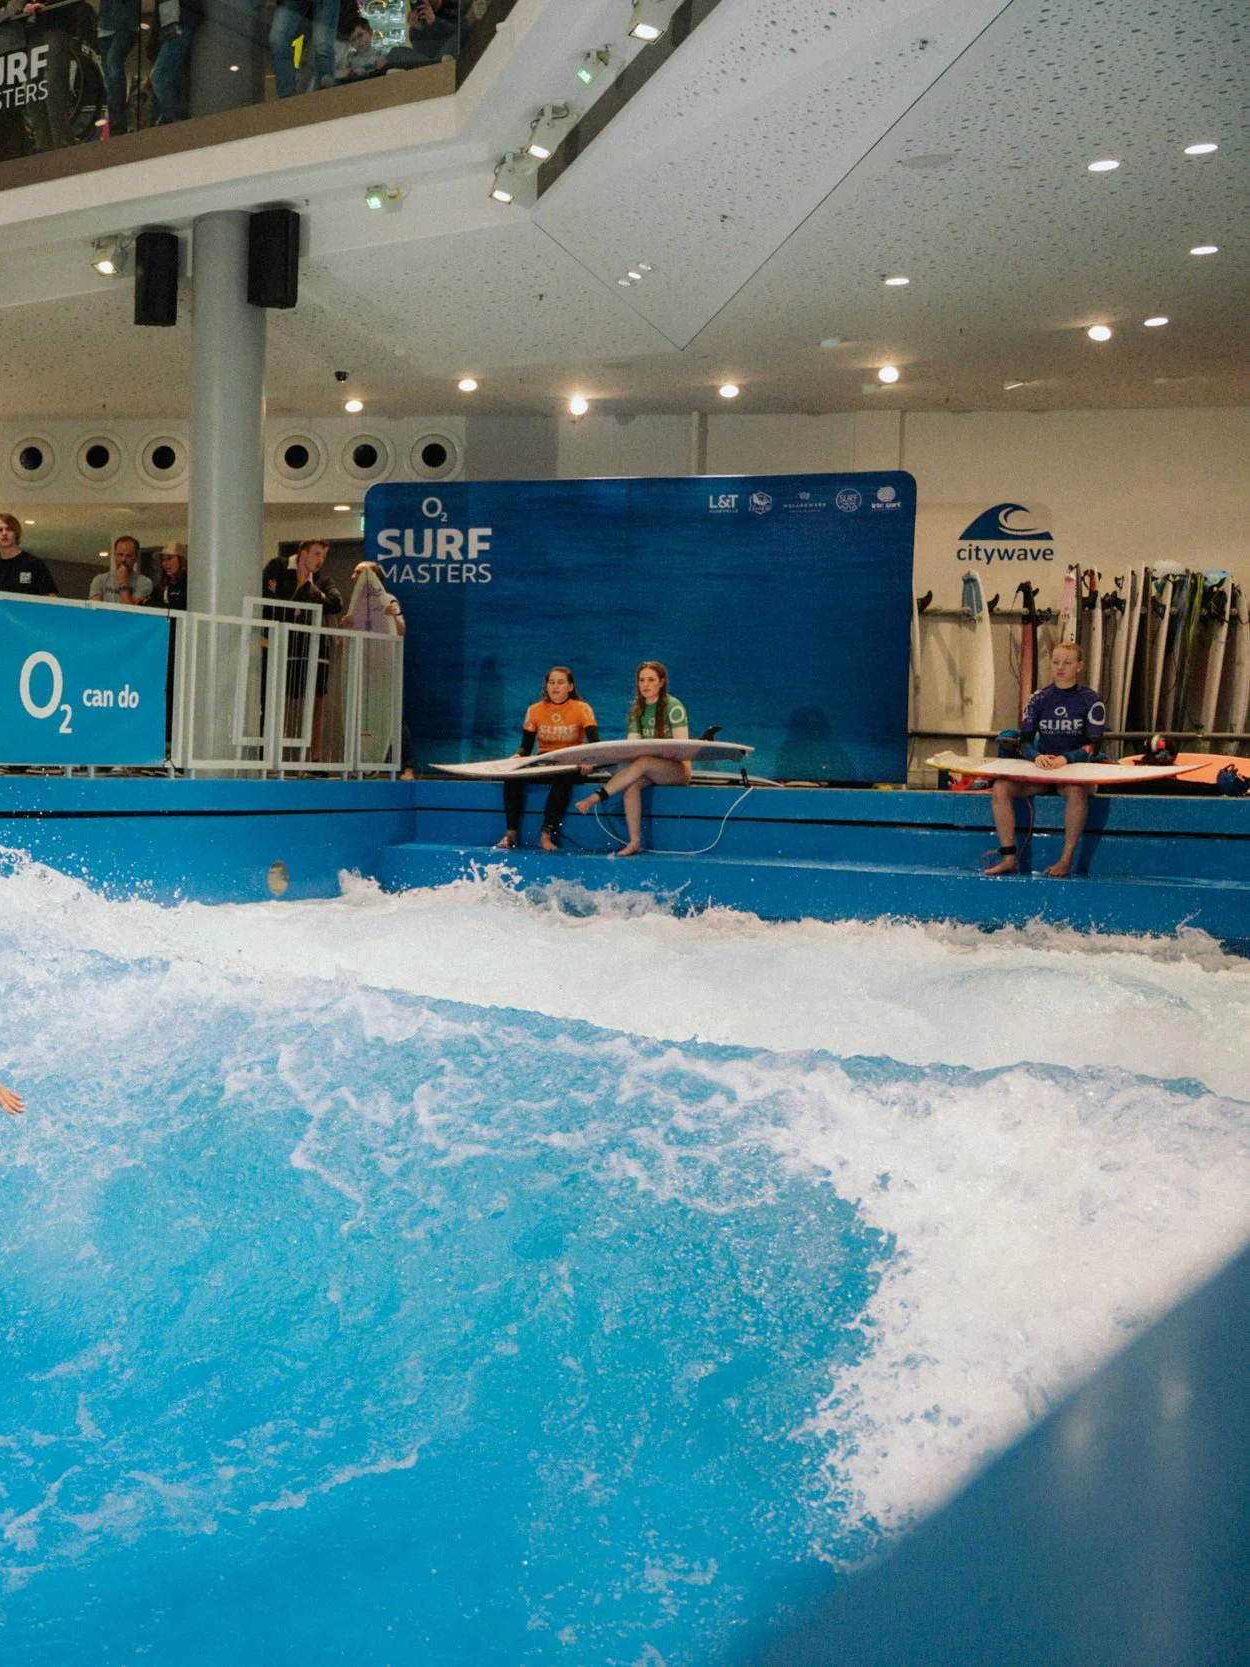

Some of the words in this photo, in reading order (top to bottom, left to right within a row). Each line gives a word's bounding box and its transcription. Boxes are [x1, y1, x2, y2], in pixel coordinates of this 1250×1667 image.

[421, 496, 448, 522] O2
[709, 494, 739, 509] L&T
[376, 527, 493, 561] SURF
[956, 544, 1055, 565] citywave
[378, 563, 493, 584] MASTERS
[19, 650, 73, 734] O2
[83, 688, 114, 707] can
[118, 684, 139, 708] do
[539, 724, 577, 735] SURF
[1038, 719, 1084, 731] SURF
